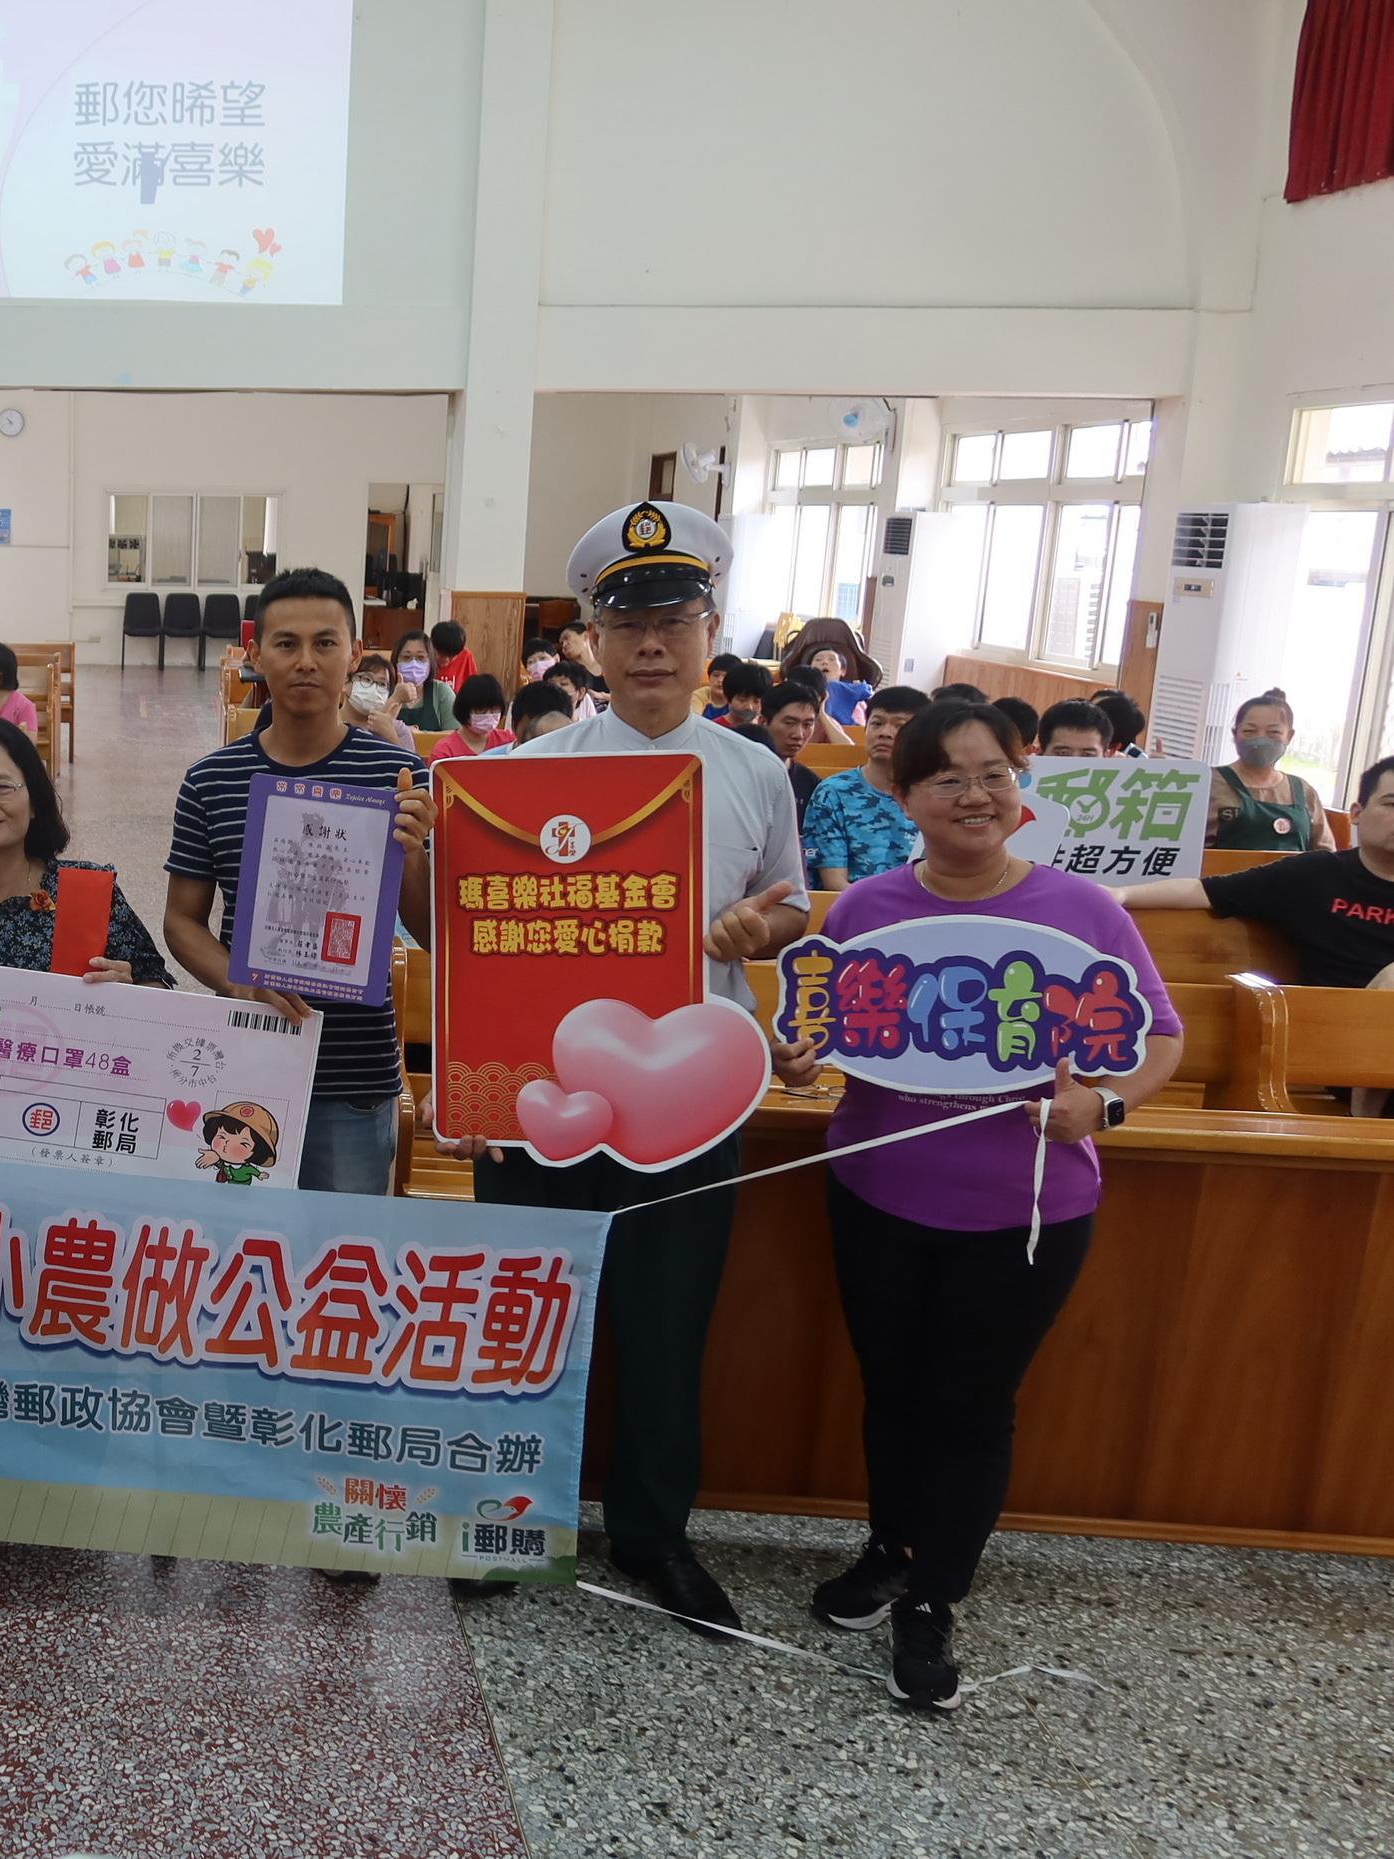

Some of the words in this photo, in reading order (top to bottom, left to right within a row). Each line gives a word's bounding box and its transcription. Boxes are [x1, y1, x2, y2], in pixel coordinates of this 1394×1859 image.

[302, 823, 347, 841] 感謝狀
[458, 872, 678, 911] 瑪喜樂社福基金會
[471, 918, 663, 955] 感謝您愛心捐款
[788, 950, 1135, 1063] 喜樂保育院
[192, 1049, 202, 1061] 2
[191, 1065, 200, 1077] 7
[95, 1108, 139, 1133] 彰化
[92, 1130, 137, 1154] 郵局
[344, 1477, 407, 1512] 關懷
[313, 1501, 437, 1552] 農產行銷
